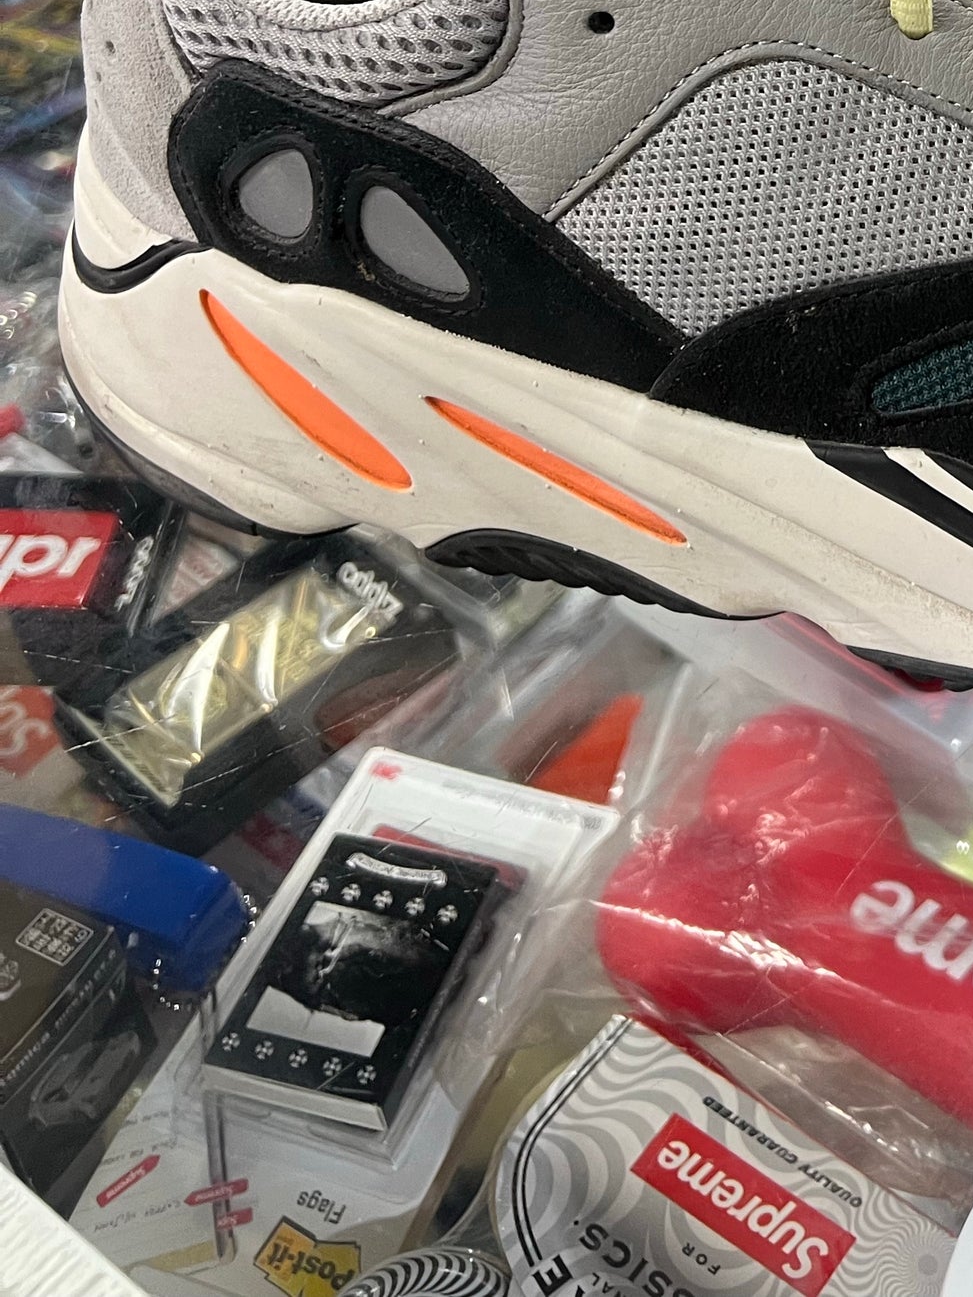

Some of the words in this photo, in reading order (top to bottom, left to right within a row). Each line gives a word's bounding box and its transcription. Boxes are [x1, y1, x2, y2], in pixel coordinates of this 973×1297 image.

[702, 1096, 799, 1164] GUARANTEED
[297, 1190, 347, 1225] Flags
[798, 1164, 863, 1208] QUALITY
[656, 1140, 829, 1279] Supreme
[266, 1242, 356, 1291] Post-it
[681, 1242, 721, 1276] FOR
